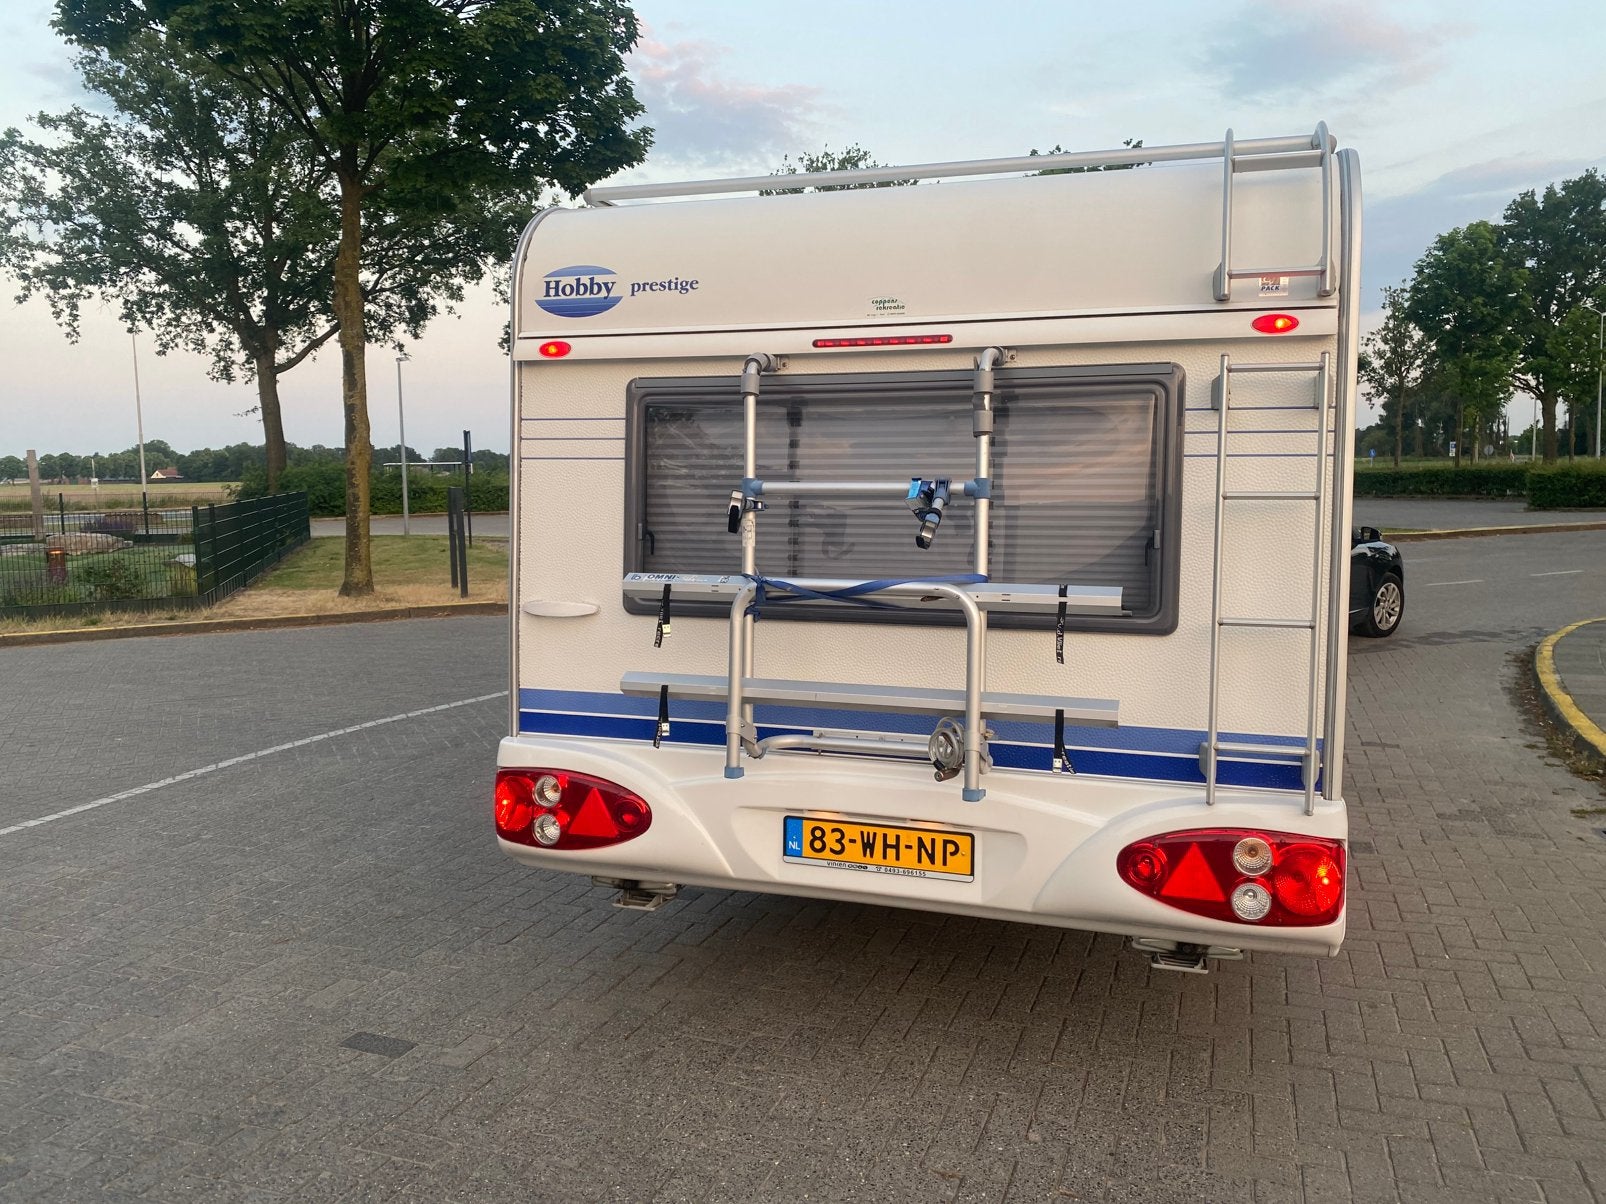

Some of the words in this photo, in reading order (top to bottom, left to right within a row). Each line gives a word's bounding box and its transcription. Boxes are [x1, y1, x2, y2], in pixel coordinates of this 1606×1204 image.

[543, 276, 617, 300] Hobby
[630, 277, 699, 297] prestige
[788, 841, 800, 850] NL
[809, 825, 960, 867] 83-WH-NP
